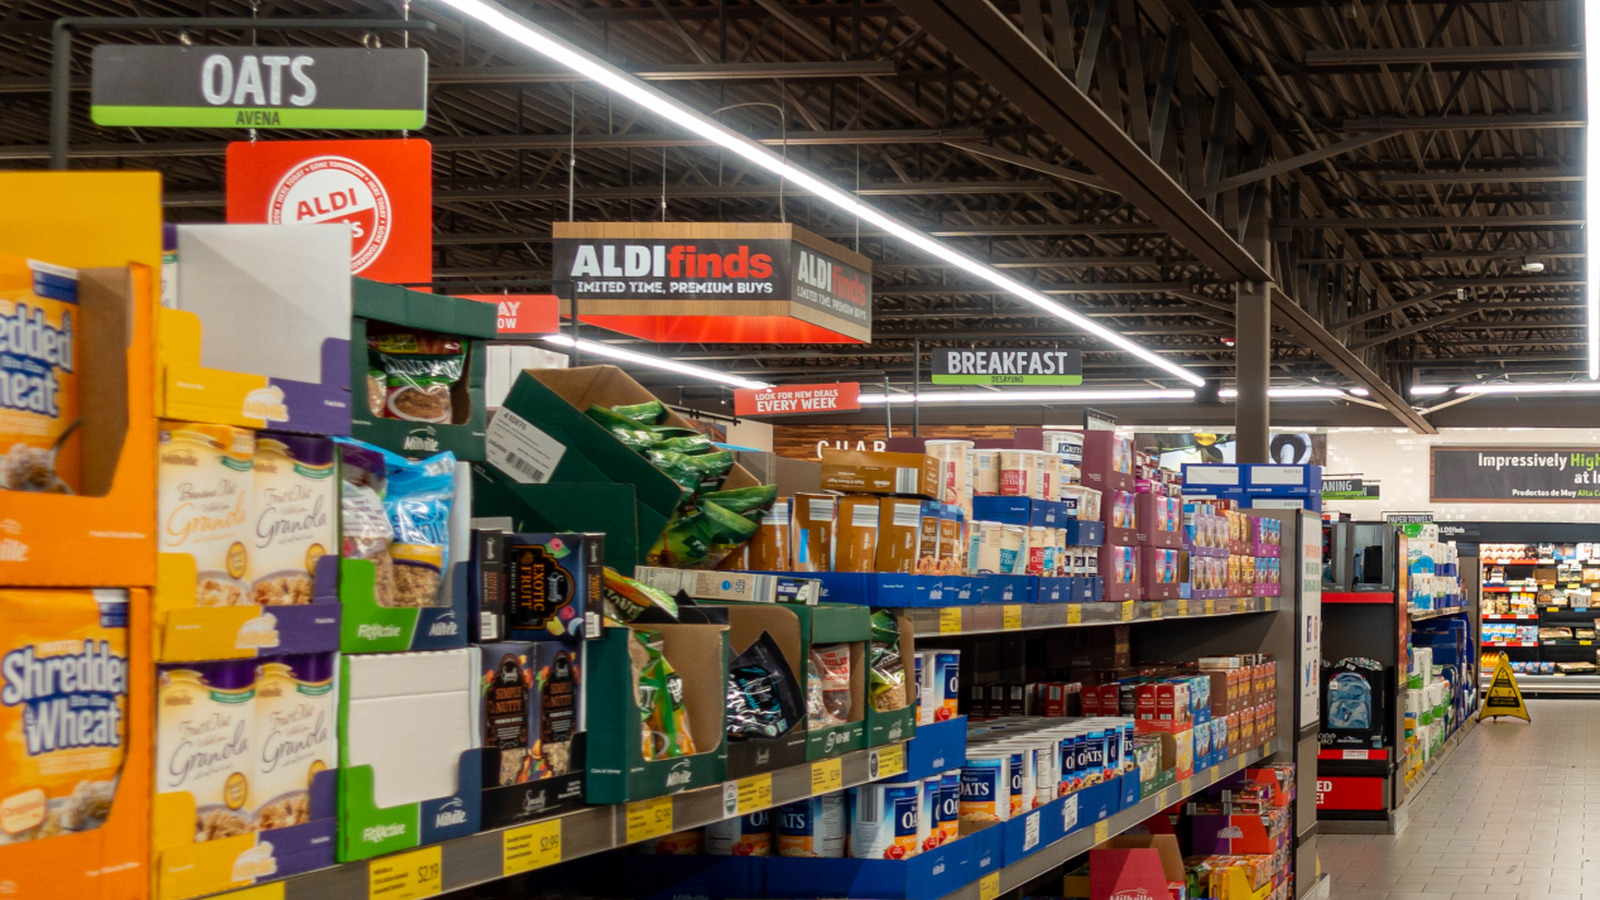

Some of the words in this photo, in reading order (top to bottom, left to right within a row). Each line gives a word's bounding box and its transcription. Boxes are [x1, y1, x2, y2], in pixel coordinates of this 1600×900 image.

[202, 54, 317, 106] OATS
[236, 110, 281, 126] AVENA
[296, 187, 358, 221] ALDI
[577, 281, 626, 293] IMITED
[629, 281, 666, 294] TIME,
[670, 281, 734, 294] PREMIUM
[737, 281, 773, 294] BUYS
[947, 351, 1068, 375] BREAKFAST
[991, 375, 1024, 384] DESAYUNO
[755, 392, 776, 401] LOOK
[777, 391, 793, 400] FOR
[794, 389, 813, 399] NEW
[814, 388, 839, 399] DEALS
[756, 399, 799, 413] EVERY
[801, 397, 837, 410] WEEK
[1477, 453, 1568, 471] Impressively
[1574, 471, 1590, 484] at
[1512, 489, 1549, 497] Productos
[1550, 489, 1560, 497] de
[1560, 489, 1577, 498] Muy
[1577, 489, 1593, 497] Alta
[256, 494, 328, 549] Granola
[1387, 515, 1408, 523] PAPER
[1408, 515, 1433, 523] TOWELS
[520, 566, 532, 610] FRUIT
[533, 563, 545, 612] EXOTIC
[26, 699, 122, 755] Wheat
[261, 710, 328, 774] Granola
[168, 720, 250, 787] Granola
